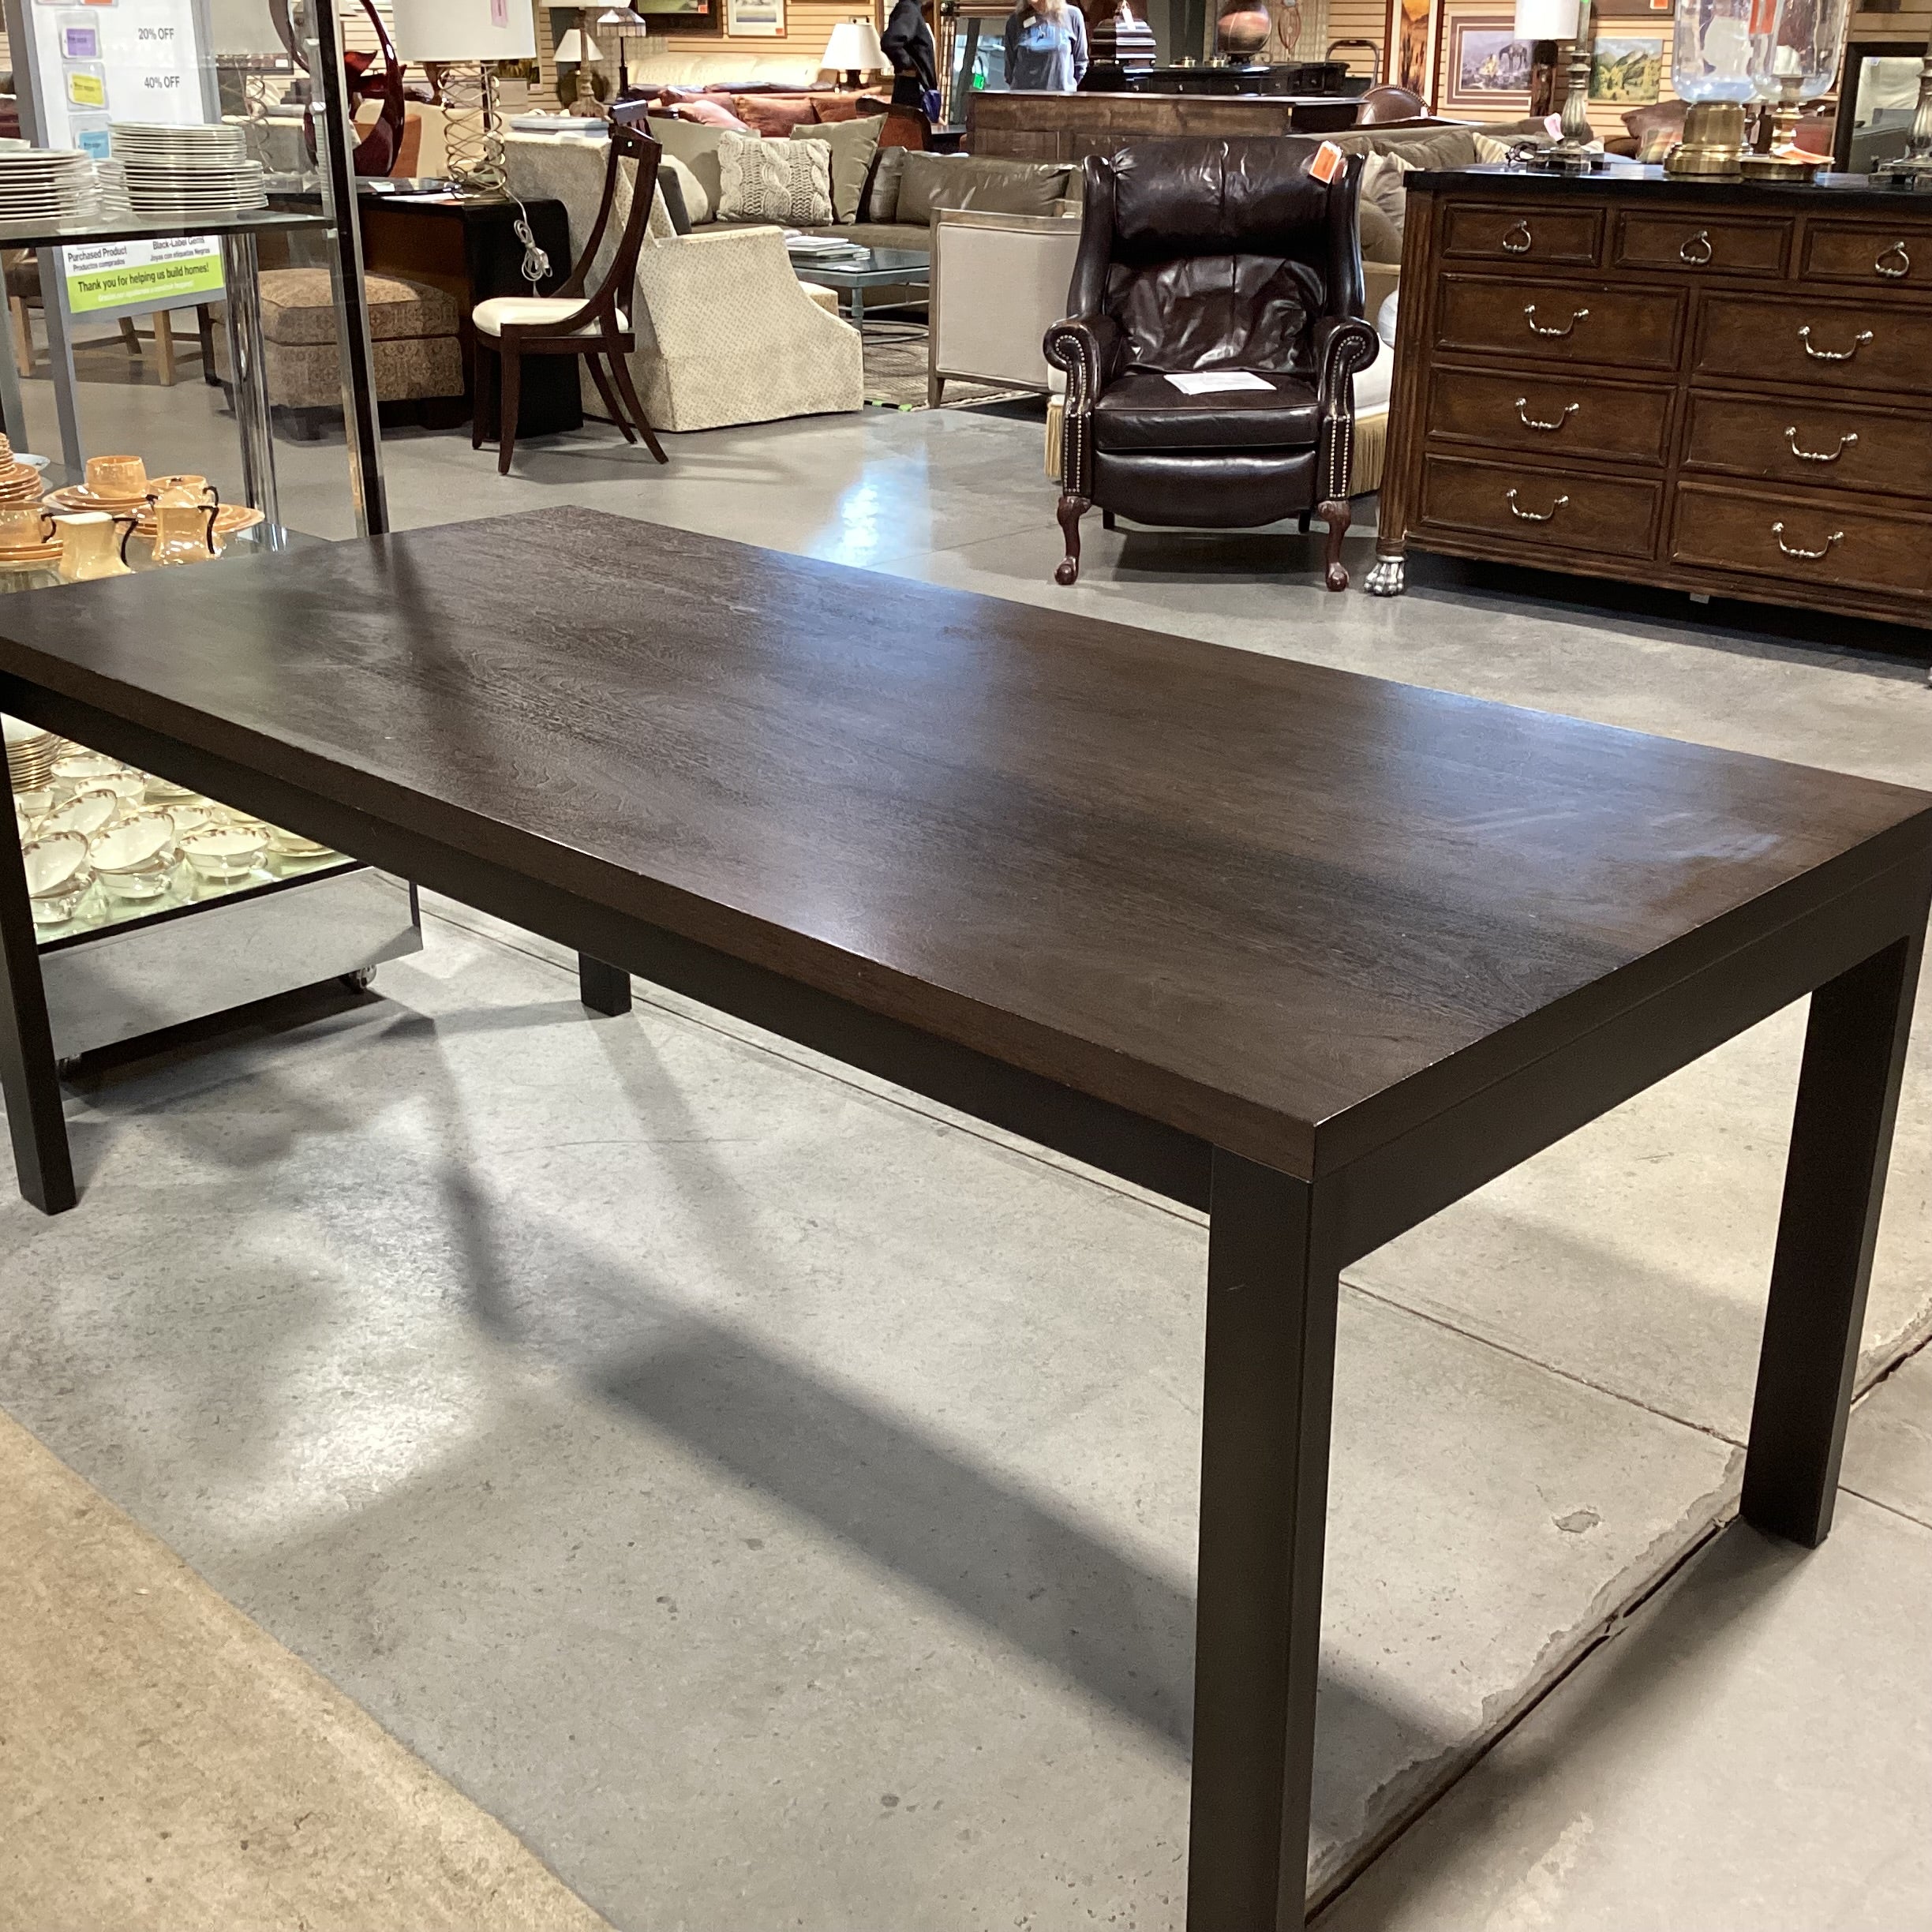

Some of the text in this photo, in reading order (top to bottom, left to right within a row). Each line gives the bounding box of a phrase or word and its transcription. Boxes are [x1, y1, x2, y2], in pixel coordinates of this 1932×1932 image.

[138, 28, 174, 40] 20% OFF
[144, 76, 180, 88] 40% OFF
[68, 246, 127, 262] Purchased Product
[77, 279, 101, 292] Thank
[103, 279, 116, 290] you
[118, 275, 128, 286] for
[129, 271, 155, 284] helping
[157, 271, 165, 280] us
[166, 265, 183, 279] build
[184, 262, 209, 275] homes!
